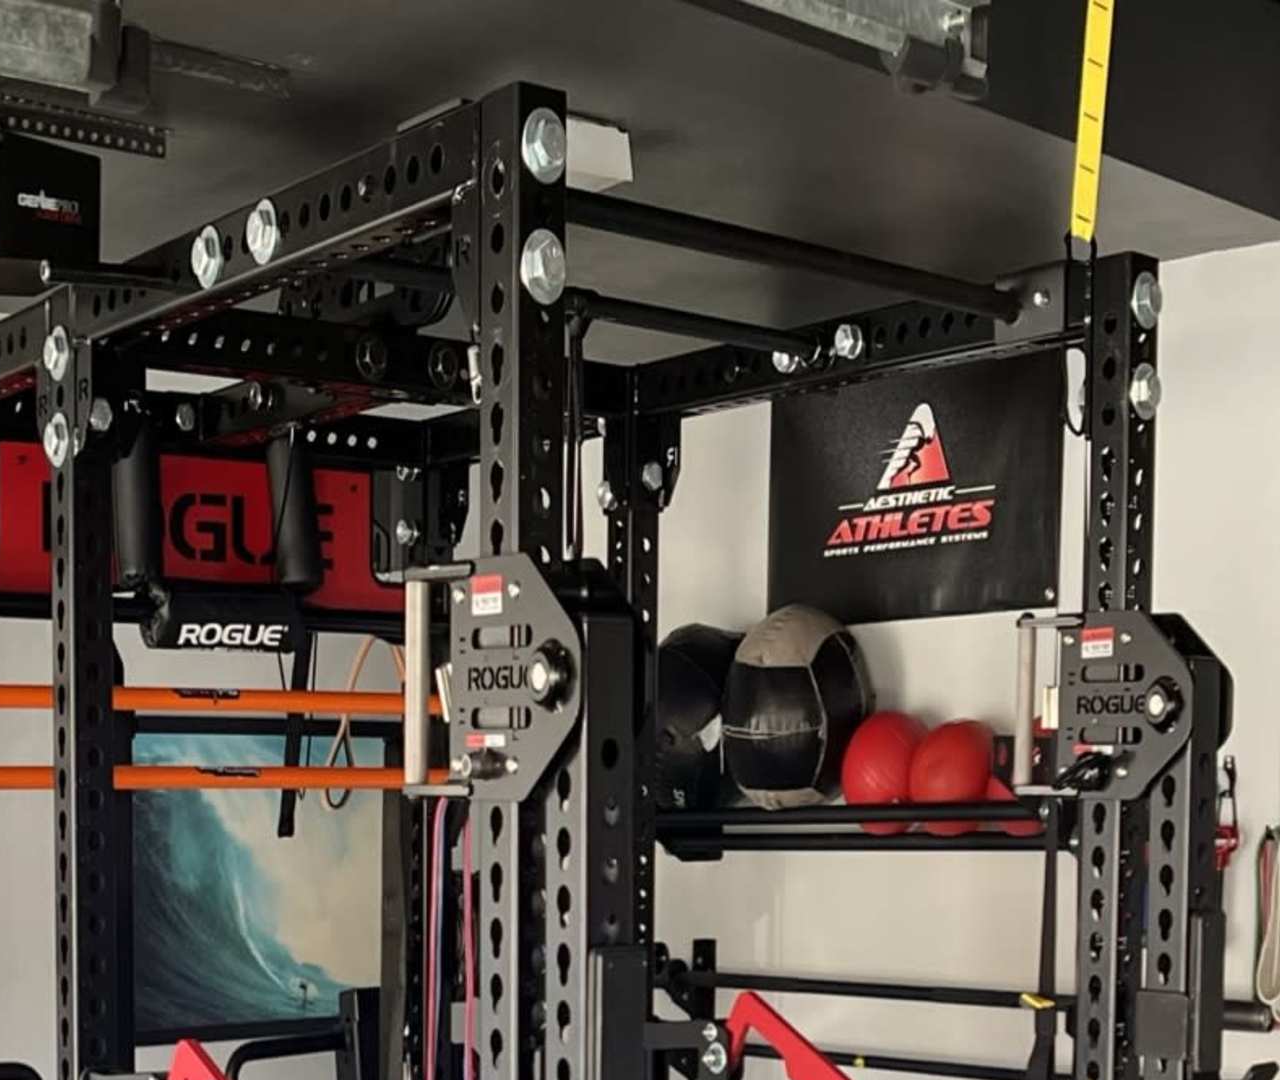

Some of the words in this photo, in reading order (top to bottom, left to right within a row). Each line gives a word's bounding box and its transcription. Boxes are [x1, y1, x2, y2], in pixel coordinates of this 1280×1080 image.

[863, 485, 956, 512] AESTHETIC
[827, 499, 996, 546] ATHLETES
[823, 545, 860, 558] SPORTS
[863, 536, 937, 553] PERFORMANCE
[177, 622, 284, 646] ROGUE
[467, 664, 528, 692] ROGU
[1076, 693, 1146, 716] ROGUE
